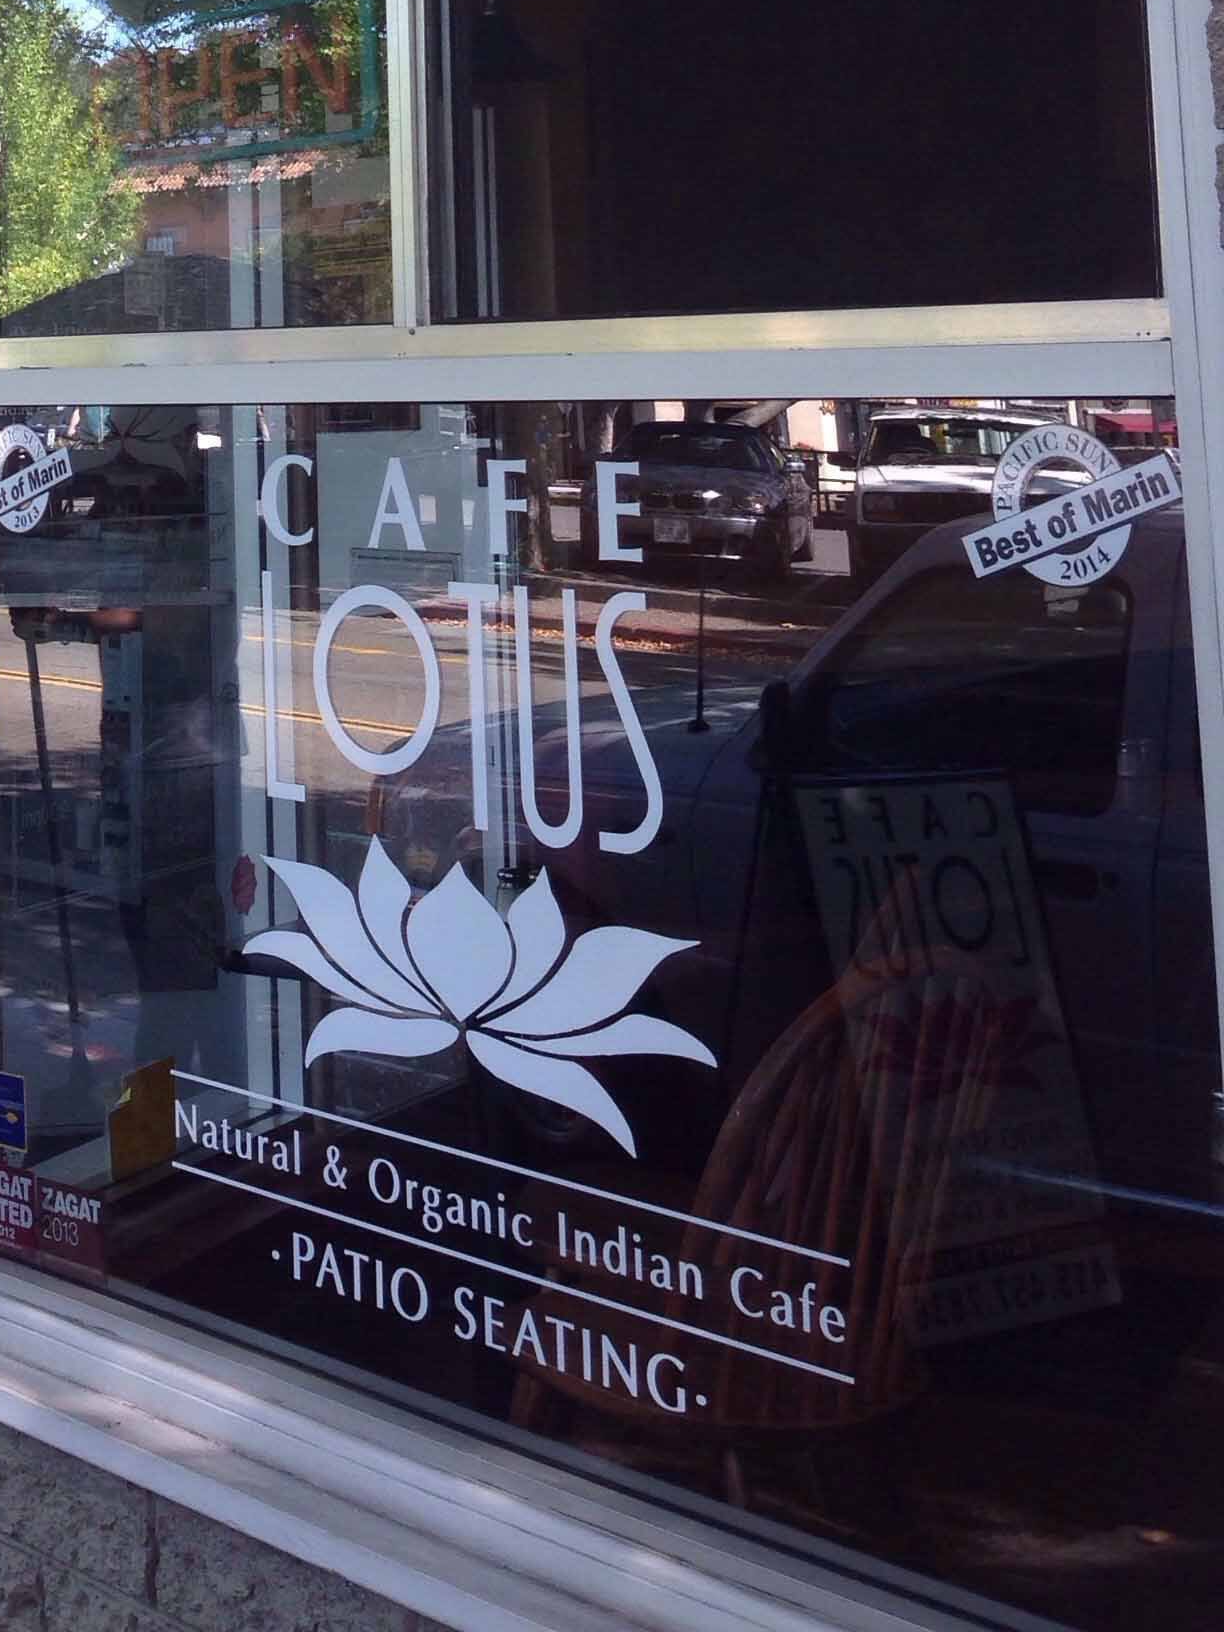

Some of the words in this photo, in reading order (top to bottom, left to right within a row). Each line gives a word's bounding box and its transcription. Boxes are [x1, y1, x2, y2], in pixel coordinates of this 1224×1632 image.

[11, 476, 24, 500] of
[28, 458, 67, 492] Marin
[261, 454, 643, 562] CAFE
[997, 431, 1059, 511] PACIFIC
[1065, 434, 1116, 473] SUN
[14, 506, 40, 527] 2013
[974, 519, 1042, 569] Best
[1047, 502, 1077, 539] of
[1081, 472, 1170, 526] Marin
[1060, 546, 1112, 580] 2014
[262, 569, 664, 854] LOTUS
[41, 1187, 102, 1225] ZAGAT
[42, 1216, 79, 1246] 2013
[175, 1099, 302, 1176] Natural
[323, 1145, 348, 1190] &
[368, 1157, 534, 1247] Organic
[558, 1211, 704, 1300] Indian
[730, 1267, 846, 1344] Cafe
[292, 1232, 429, 1322] PATIO
[454, 1286, 687, 1414] SEATING
